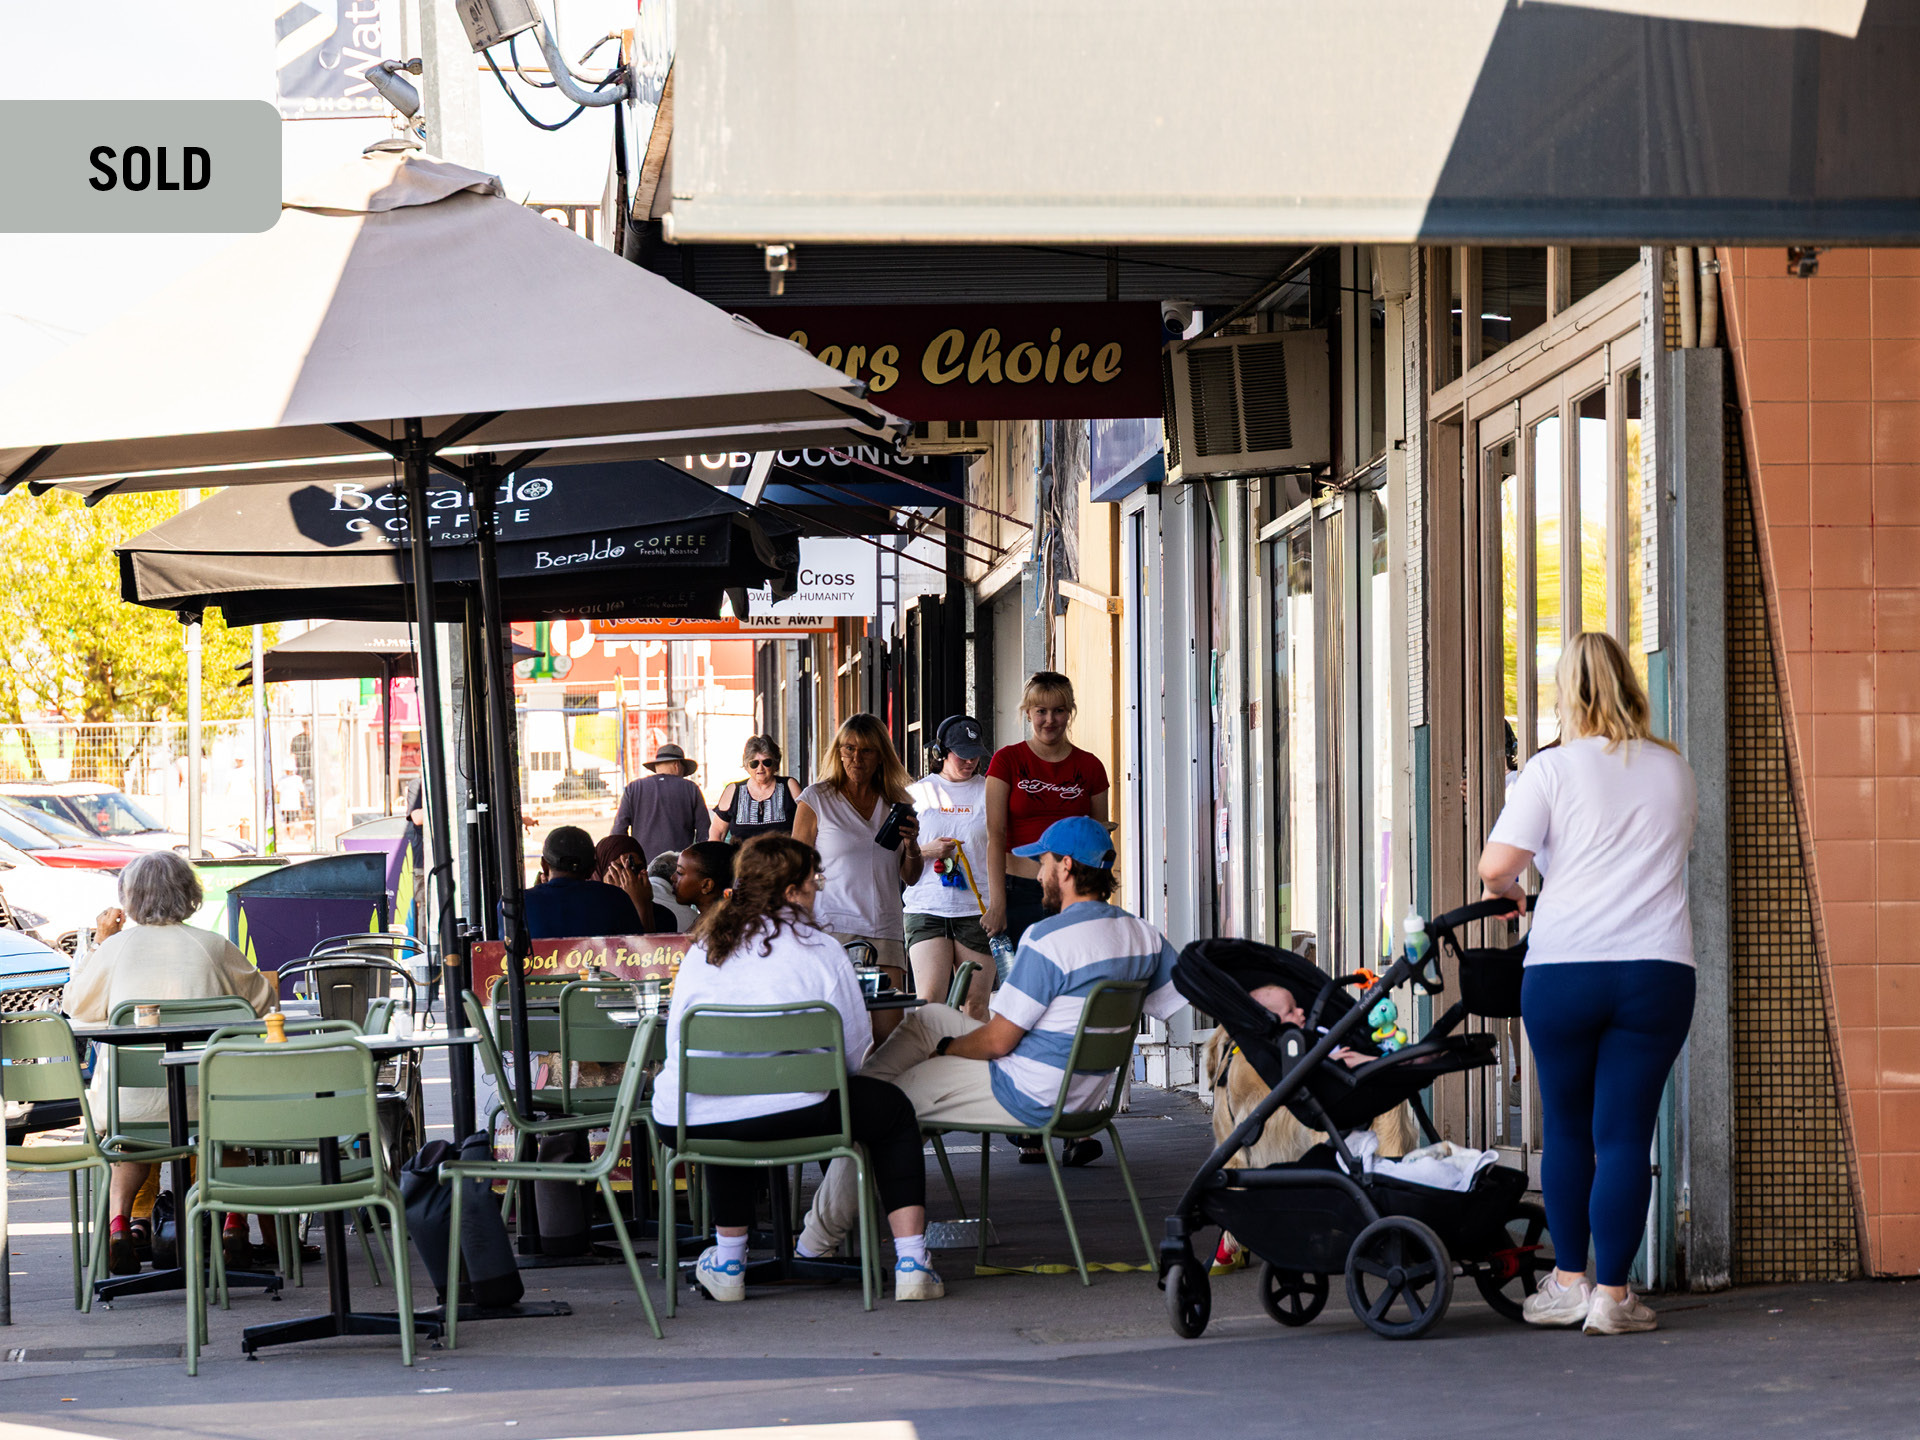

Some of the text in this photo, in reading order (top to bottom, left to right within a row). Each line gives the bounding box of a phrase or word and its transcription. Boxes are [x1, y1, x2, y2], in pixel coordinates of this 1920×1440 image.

[788, 327, 1122, 392] ers Choice
[535, 535, 706, 569] Beraldo COFFEE
[640, 547, 699, 556] Freshly Roasted
[800, 569, 855, 586] Cross
[800, 592, 855, 601] HUMANITY
[565, 949, 607, 969] Old
